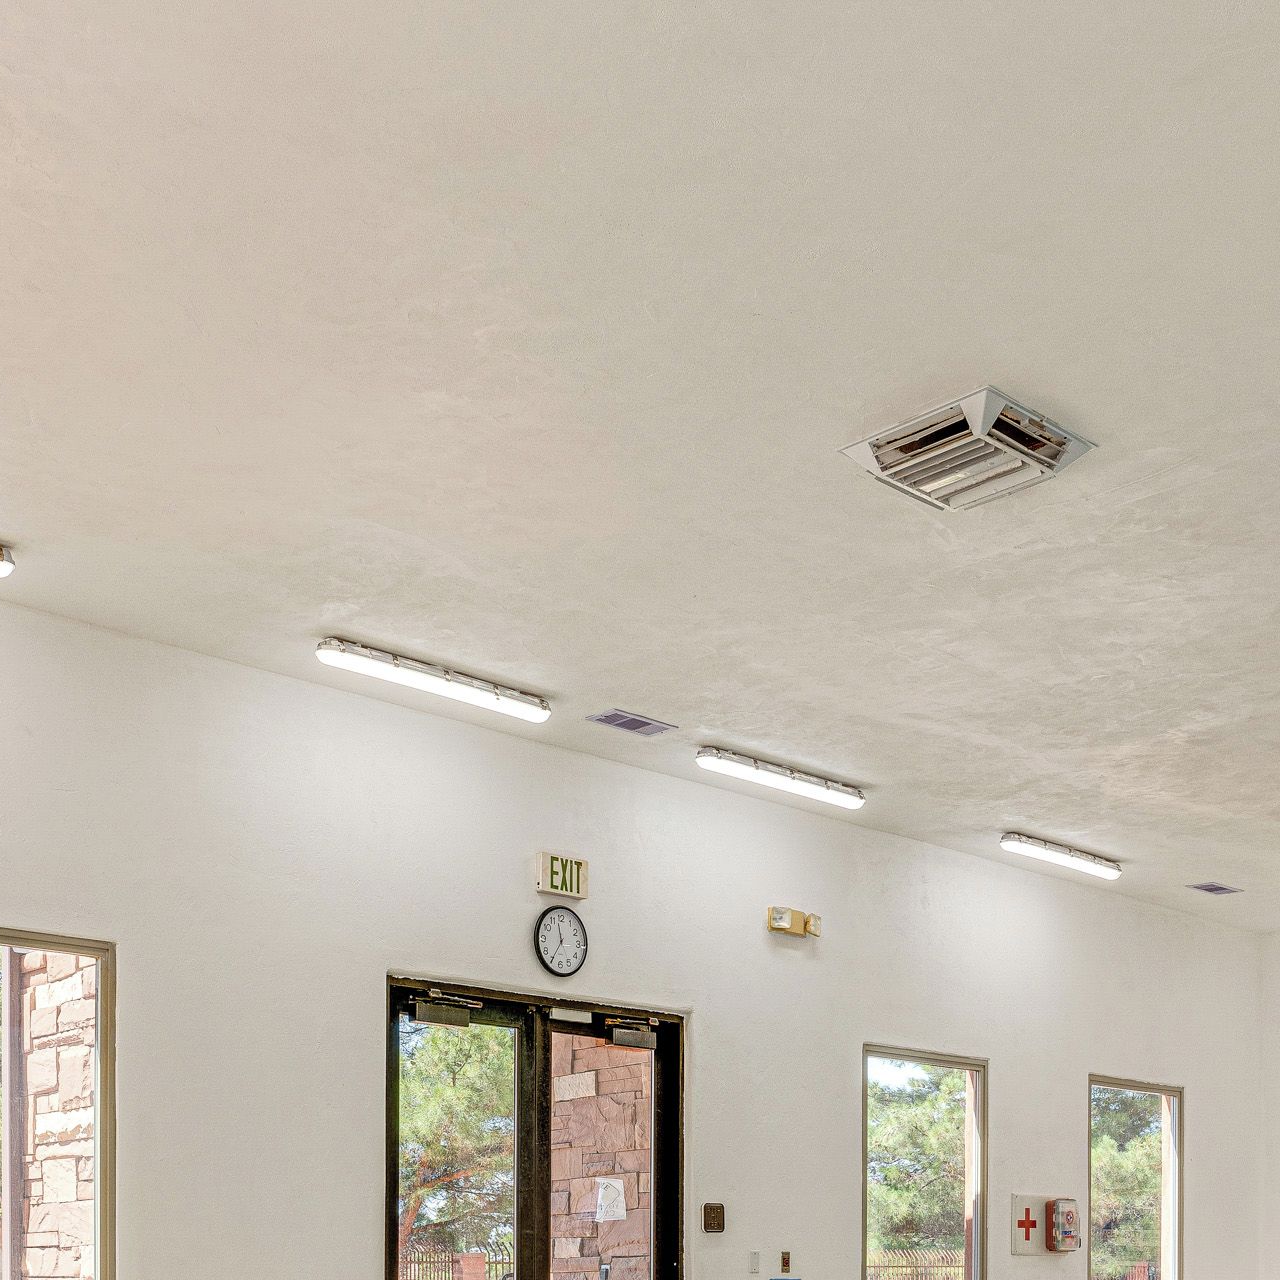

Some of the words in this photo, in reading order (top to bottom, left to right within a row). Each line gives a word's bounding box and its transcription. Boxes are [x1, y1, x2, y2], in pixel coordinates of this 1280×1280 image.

[550, 856, 582, 894] EXIT
[550, 916, 556, 924] 11
[544, 924, 551, 932] 10
[573, 928, 578, 936] 2
[540, 934, 546, 942] 9
[576, 940, 580, 948] 3
[543, 947, 548, 955] 8
[573, 952, 578, 960] 4
[558, 961, 563, 969] 6
[567, 959, 571, 967] 5
